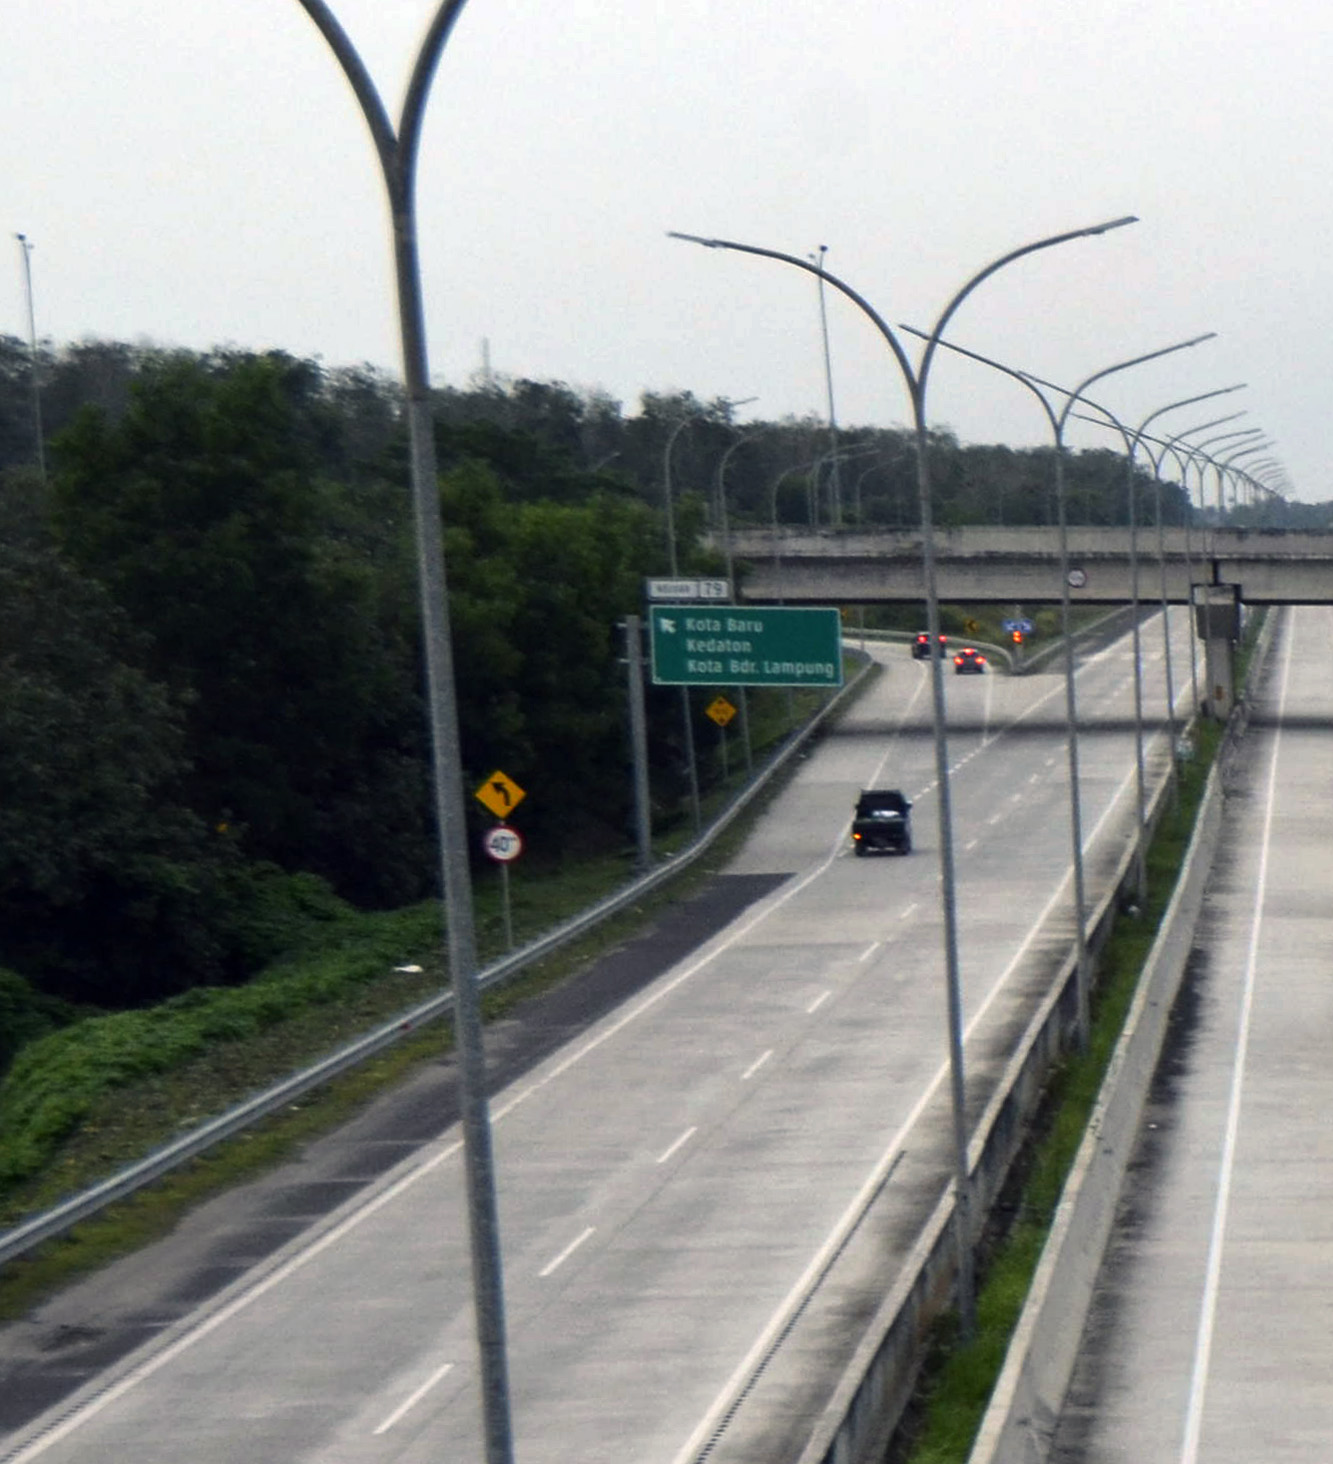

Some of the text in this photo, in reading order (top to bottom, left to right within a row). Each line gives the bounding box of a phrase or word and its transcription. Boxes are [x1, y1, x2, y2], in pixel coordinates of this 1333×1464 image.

[704, 582, 722, 596] 79
[685, 618, 763, 632] Kota Baru
[686, 638, 752, 653] Kedaton
[687, 659, 834, 678] Kota Bdr. Lampung
[490, 836, 510, 852] 40
